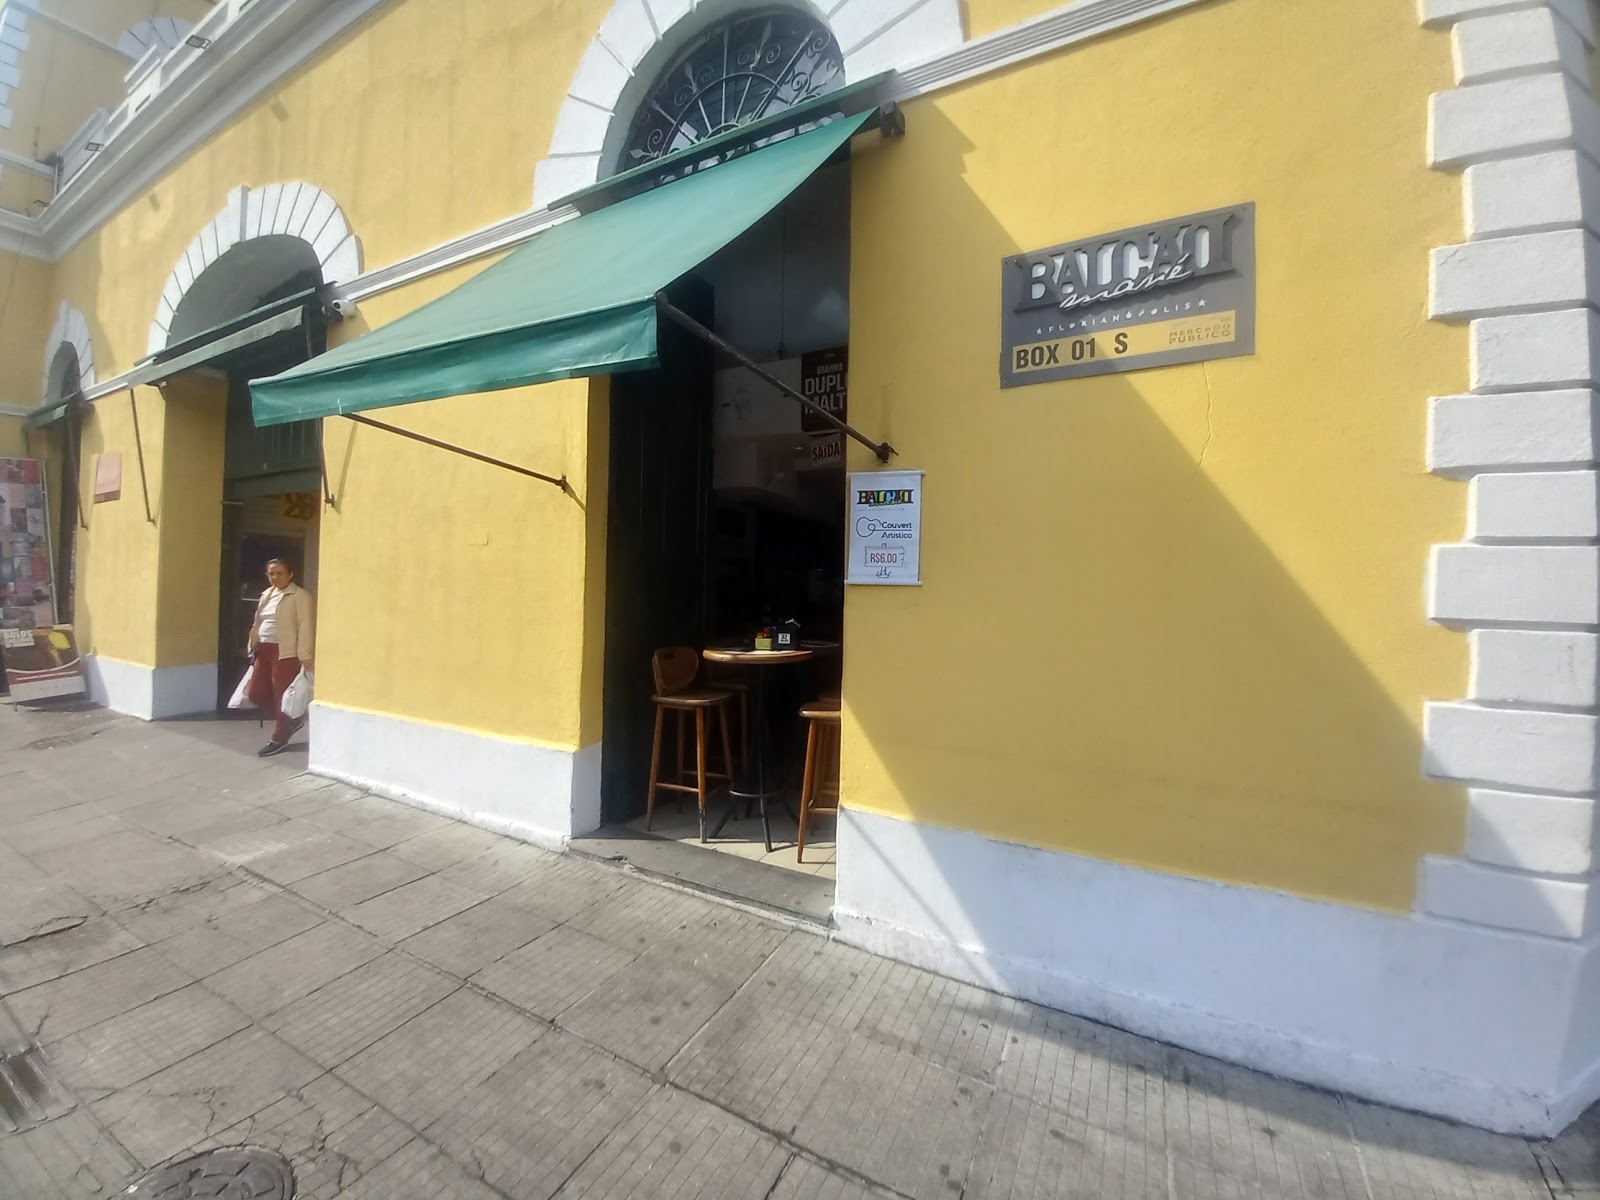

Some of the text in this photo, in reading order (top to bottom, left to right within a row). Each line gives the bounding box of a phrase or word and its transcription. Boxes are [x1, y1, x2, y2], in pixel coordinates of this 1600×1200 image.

[1169, 323, 1231, 337] MERCADO
[1015, 332, 1128, 369] BOX 01 S
